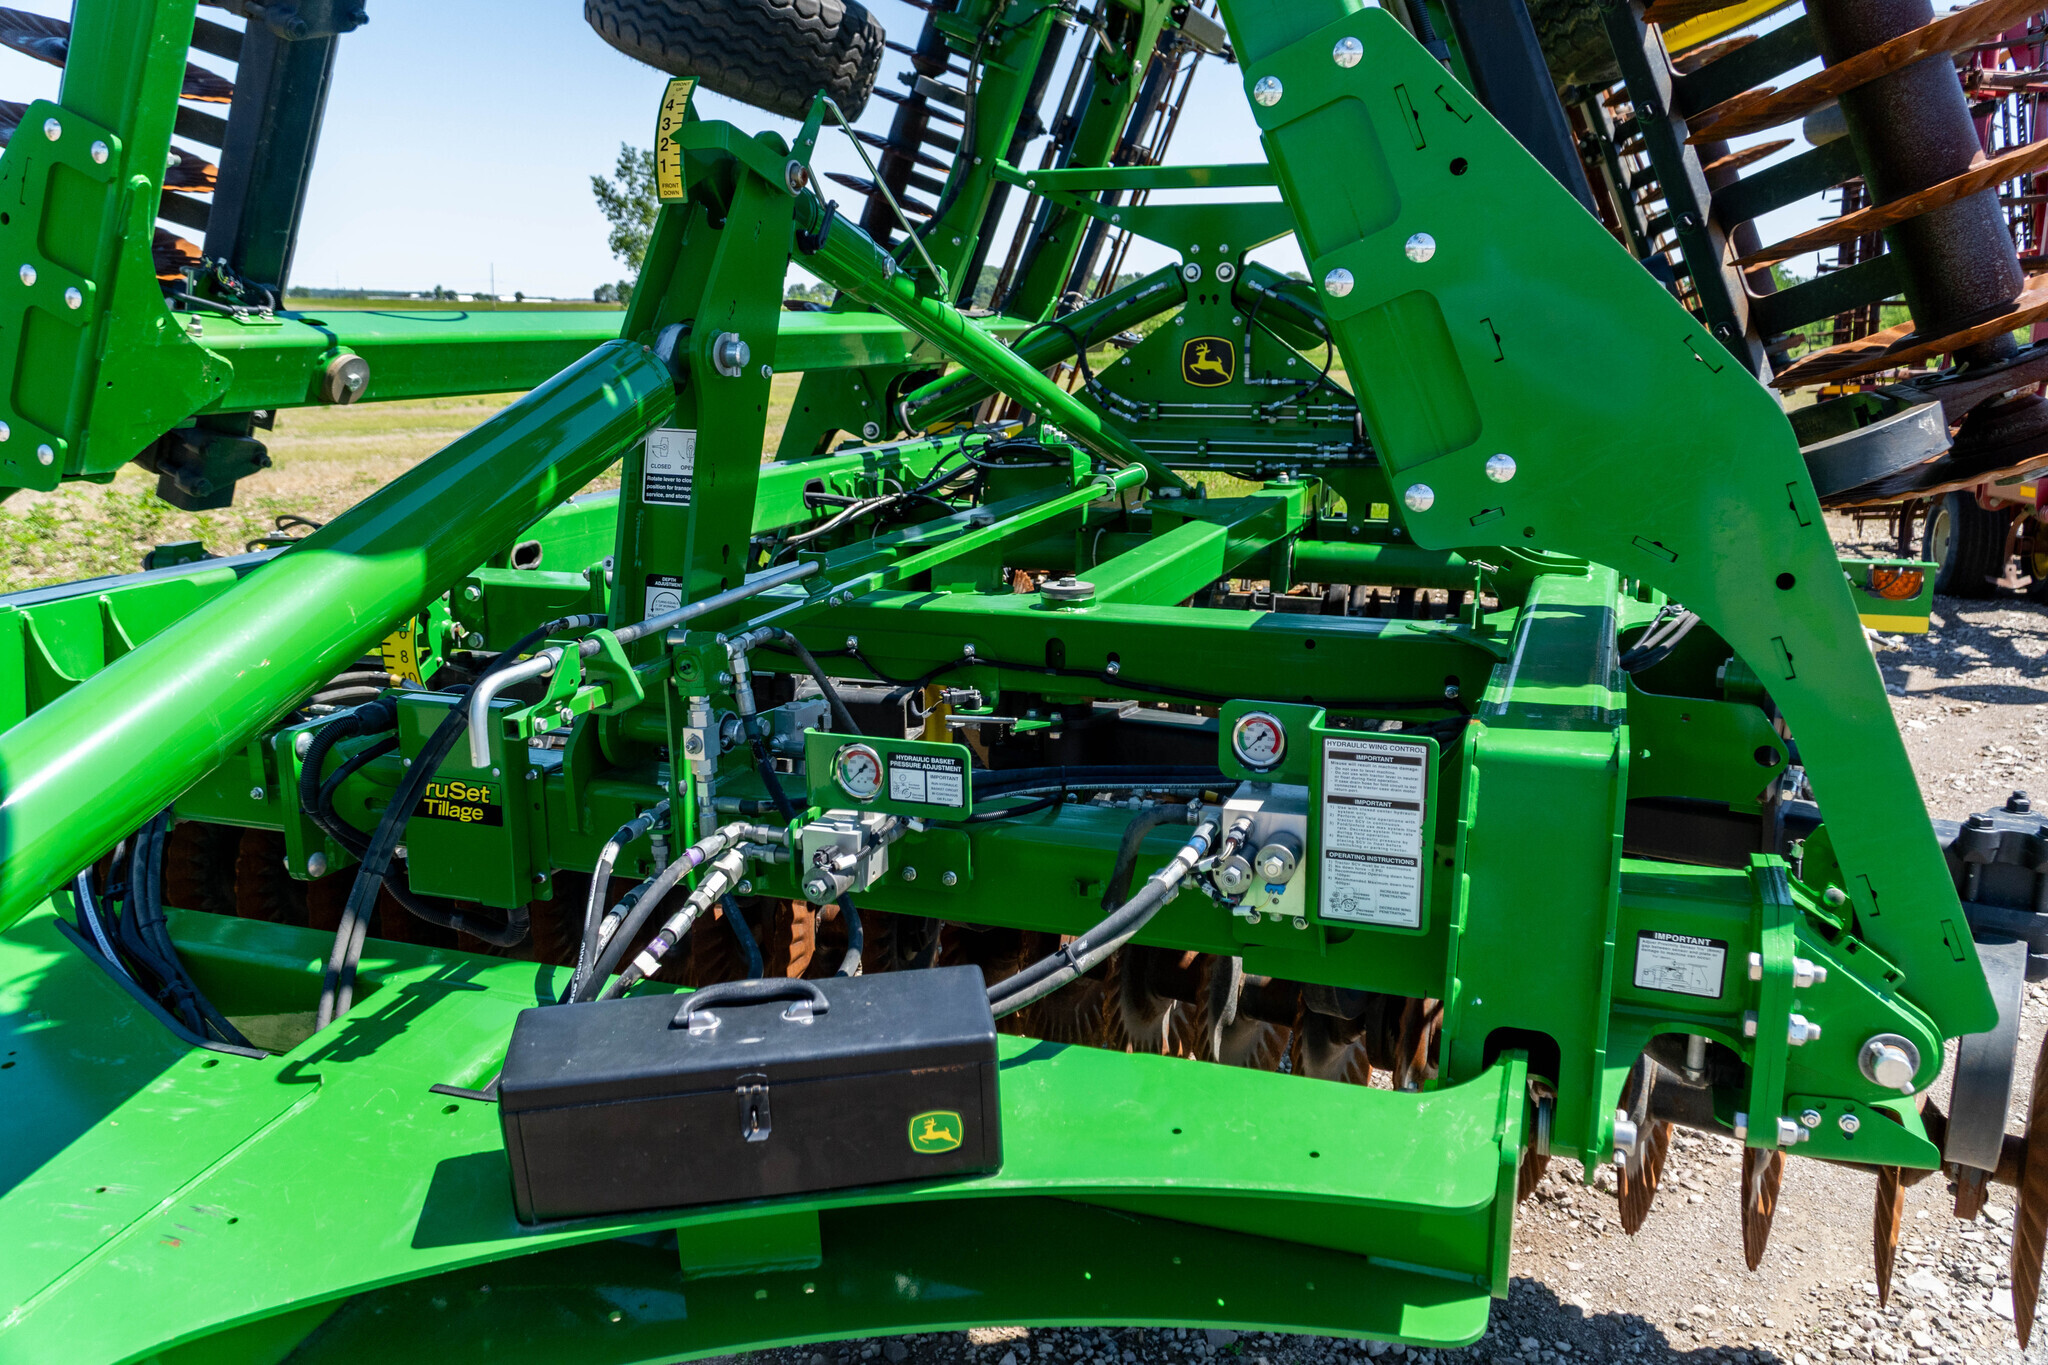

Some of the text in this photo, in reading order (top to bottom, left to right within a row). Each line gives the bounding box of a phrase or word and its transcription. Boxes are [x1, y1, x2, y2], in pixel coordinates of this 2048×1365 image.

[666, 99, 674, 111] 4
[662, 118, 670, 130] 3
[660, 138, 668, 152] 2
[660, 159, 666, 173] 1
[401, 650, 408, 663] 8
[1327, 741, 1367, 749] HYDRAULIC
[1390, 746, 1424, 754] CONTROL
[896, 754, 929, 763] HYDRAULIC
[1356, 754, 1394, 763] IMPORTANT
[890, 760, 961, 773] PRESSURE ADJUSTMENT
[425, 782, 490, 803] ruSet
[1354, 799, 1392, 807] IMPORTANT
[424, 799, 484, 822] Tillage
[1329, 852, 1414, 865] OPERATING INSTRUCTIONS
[1654, 932, 1711, 946] IMPORTANT
